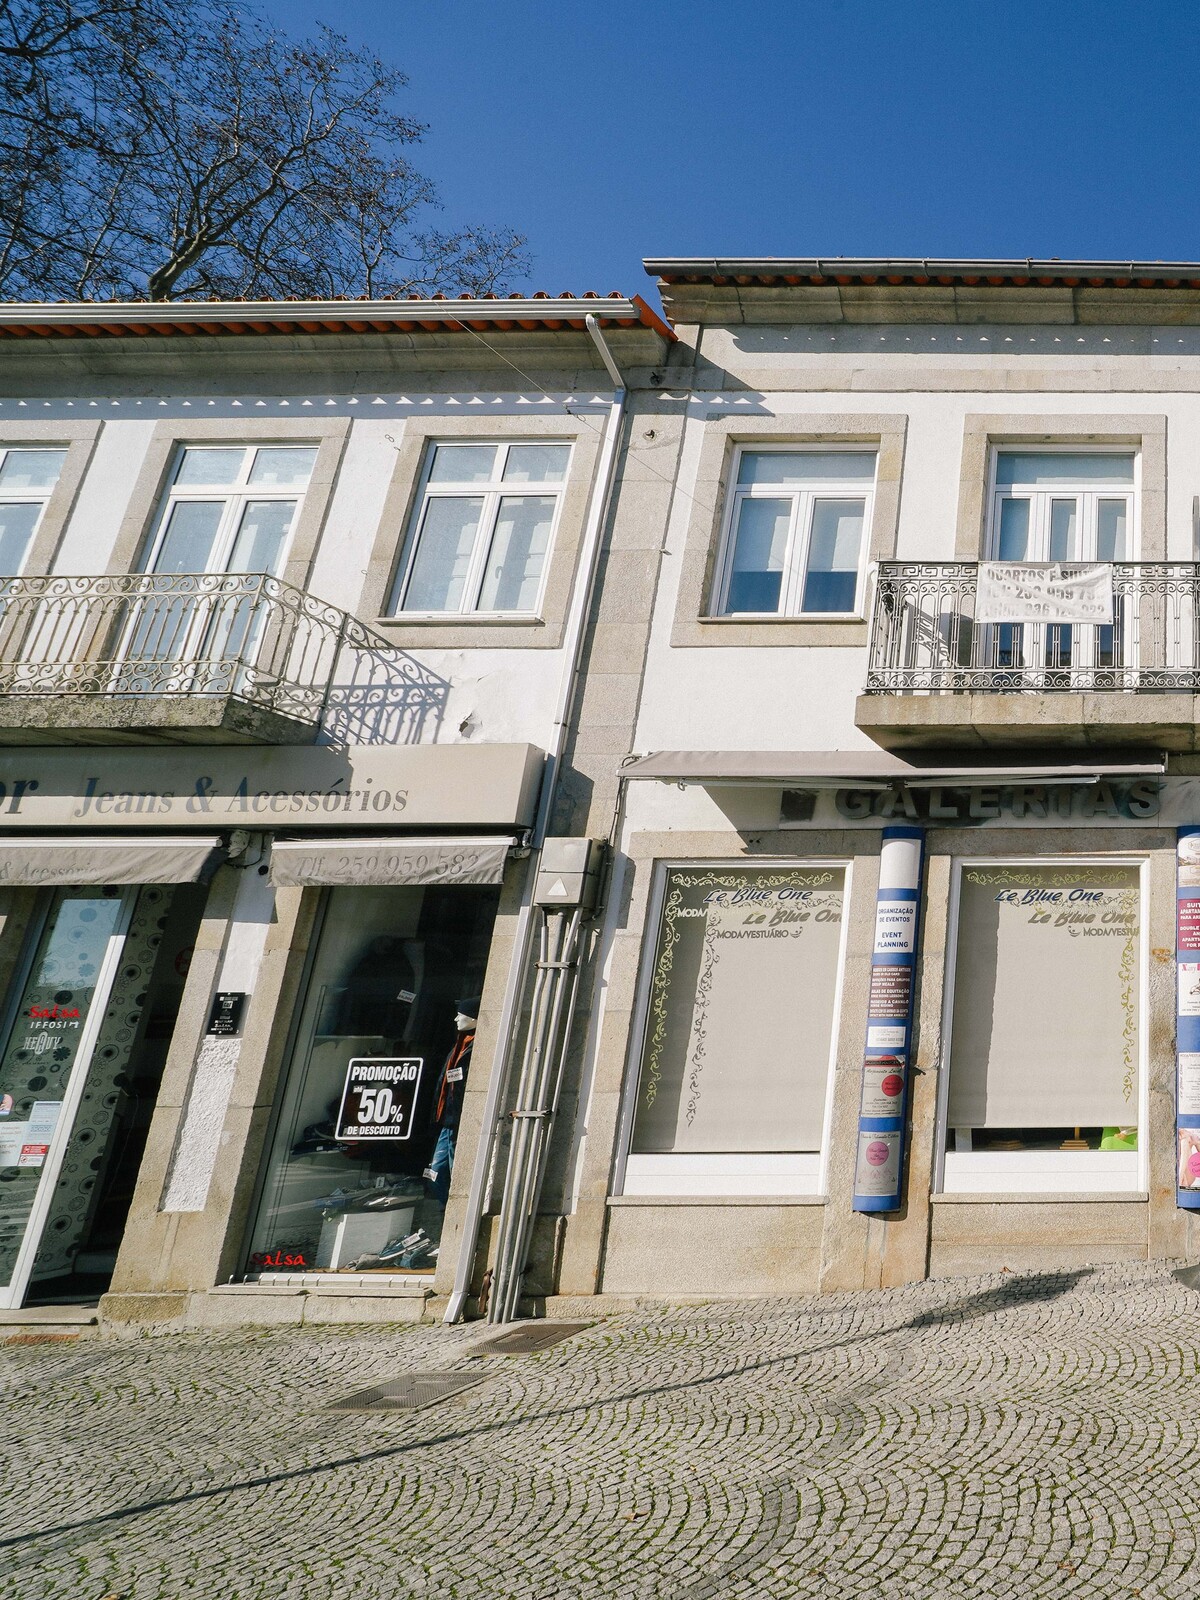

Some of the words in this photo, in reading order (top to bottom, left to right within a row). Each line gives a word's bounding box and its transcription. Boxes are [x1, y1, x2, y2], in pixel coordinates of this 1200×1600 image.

[0, 779, 39, 815] r
[74, 777, 175, 818] Jeans
[186, 776, 218, 813] &
[224, 777, 409, 813] Acessórios
[835, 780, 1162, 819] GALERIAS
[336, 855, 378, 877] 259
[703, 889, 727, 904] Le
[731, 887, 773, 905] Blue
[777, 887, 814, 901] One
[995, 889, 1018, 902] Le
[1020, 888, 1063, 905] Blue
[1068, 888, 1104, 902] One
[28, 1004, 81, 1018] Salsa
[351, 1063, 417, 1085] PROMOÇÃO
[347, 1125, 358, 1135] DE
[360, 1125, 400, 1135] DESCONTO
